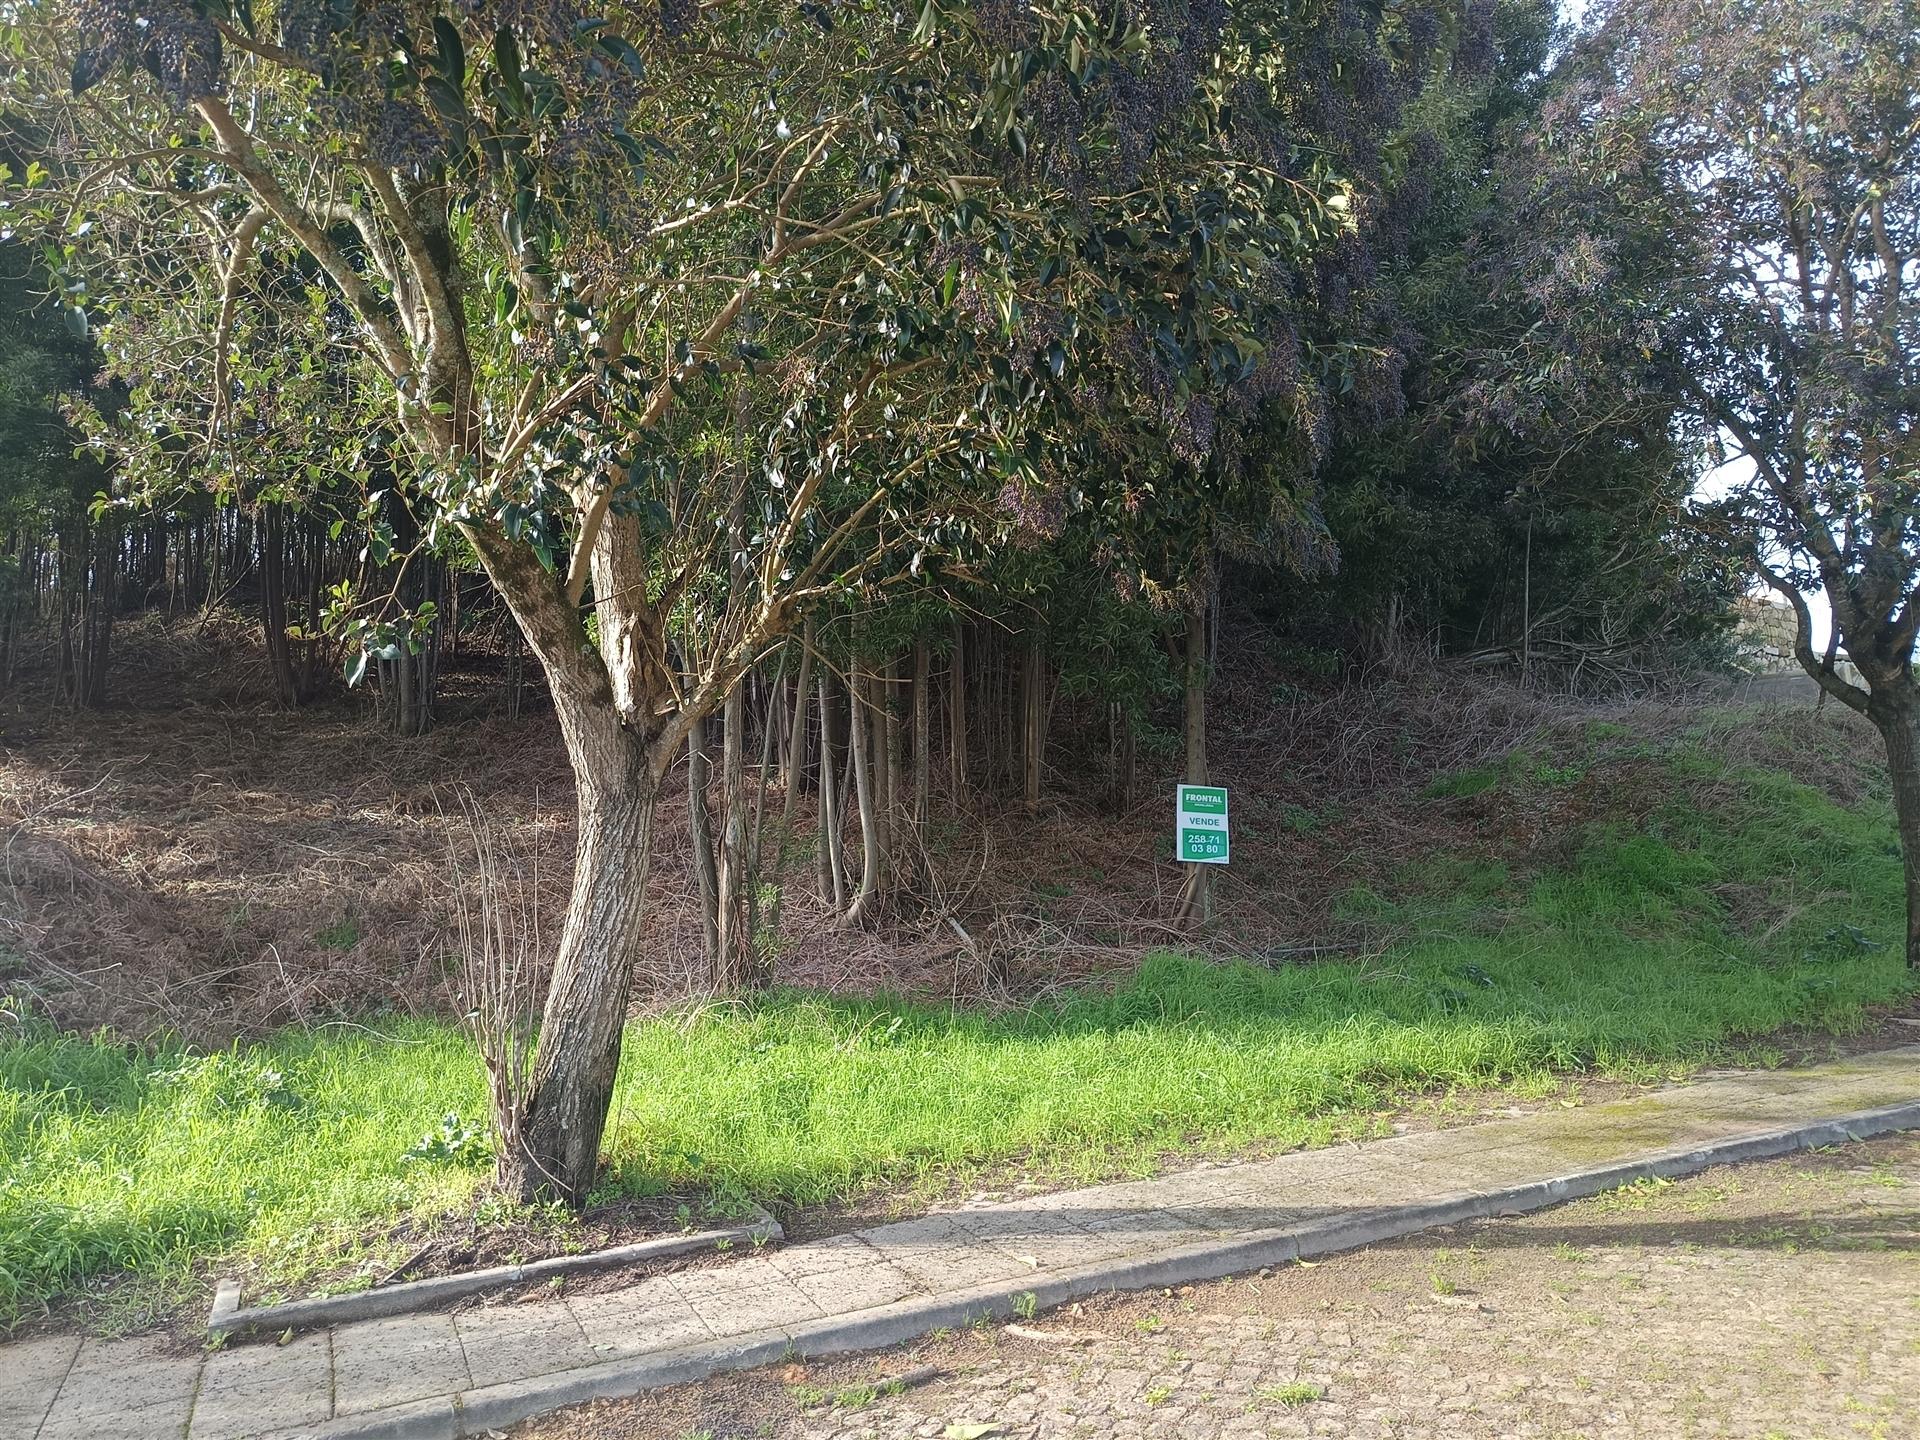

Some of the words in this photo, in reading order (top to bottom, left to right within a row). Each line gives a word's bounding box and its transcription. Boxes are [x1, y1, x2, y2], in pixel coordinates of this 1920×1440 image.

[1185, 793, 1222, 803] FRONTAL
[1189, 817, 1220, 826] VENDE
[1188, 835, 1206, 843] 258
[1208, 835, 1220, 844] 71
[1191, 844, 1204, 853] 03
[1206, 844, 1218, 853] 80
